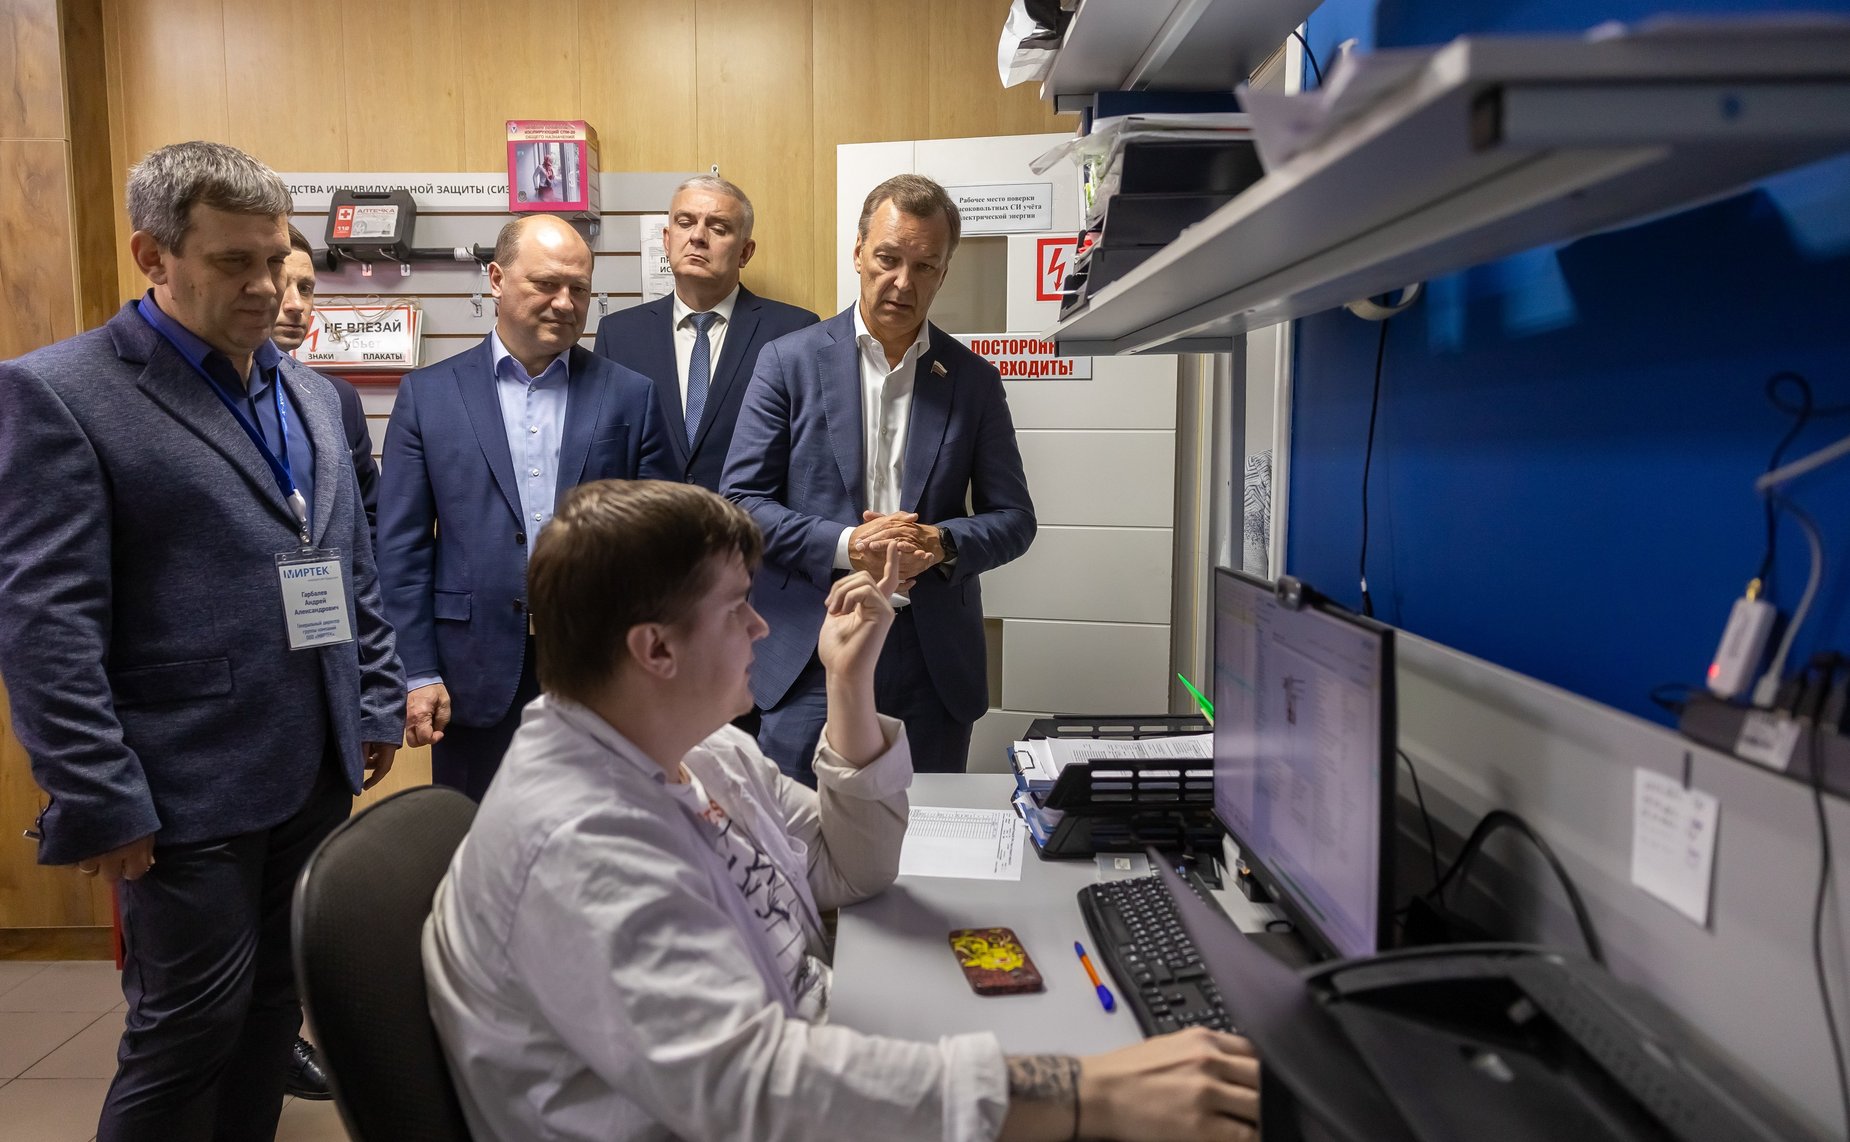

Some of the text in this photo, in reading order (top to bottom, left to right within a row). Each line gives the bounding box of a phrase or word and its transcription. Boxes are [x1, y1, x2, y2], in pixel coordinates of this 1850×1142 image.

[437, 185, 485, 195] ЗАЩИТЫ
[959, 196, 985, 204] Рабочее
[1006, 195, 1035, 203] поверки
[1010, 203, 1022, 211] СИ
[1023, 203, 1042, 211] учёта
[960, 213, 1036, 221] лектрической энергии
[324, 319, 402, 333] НЕ ВЛЕЗАЙ
[999, 360, 1074, 378] ВХОДИТЬ!
[305, 598, 327, 606] Андрей
[294, 606, 339, 615] Александрович
